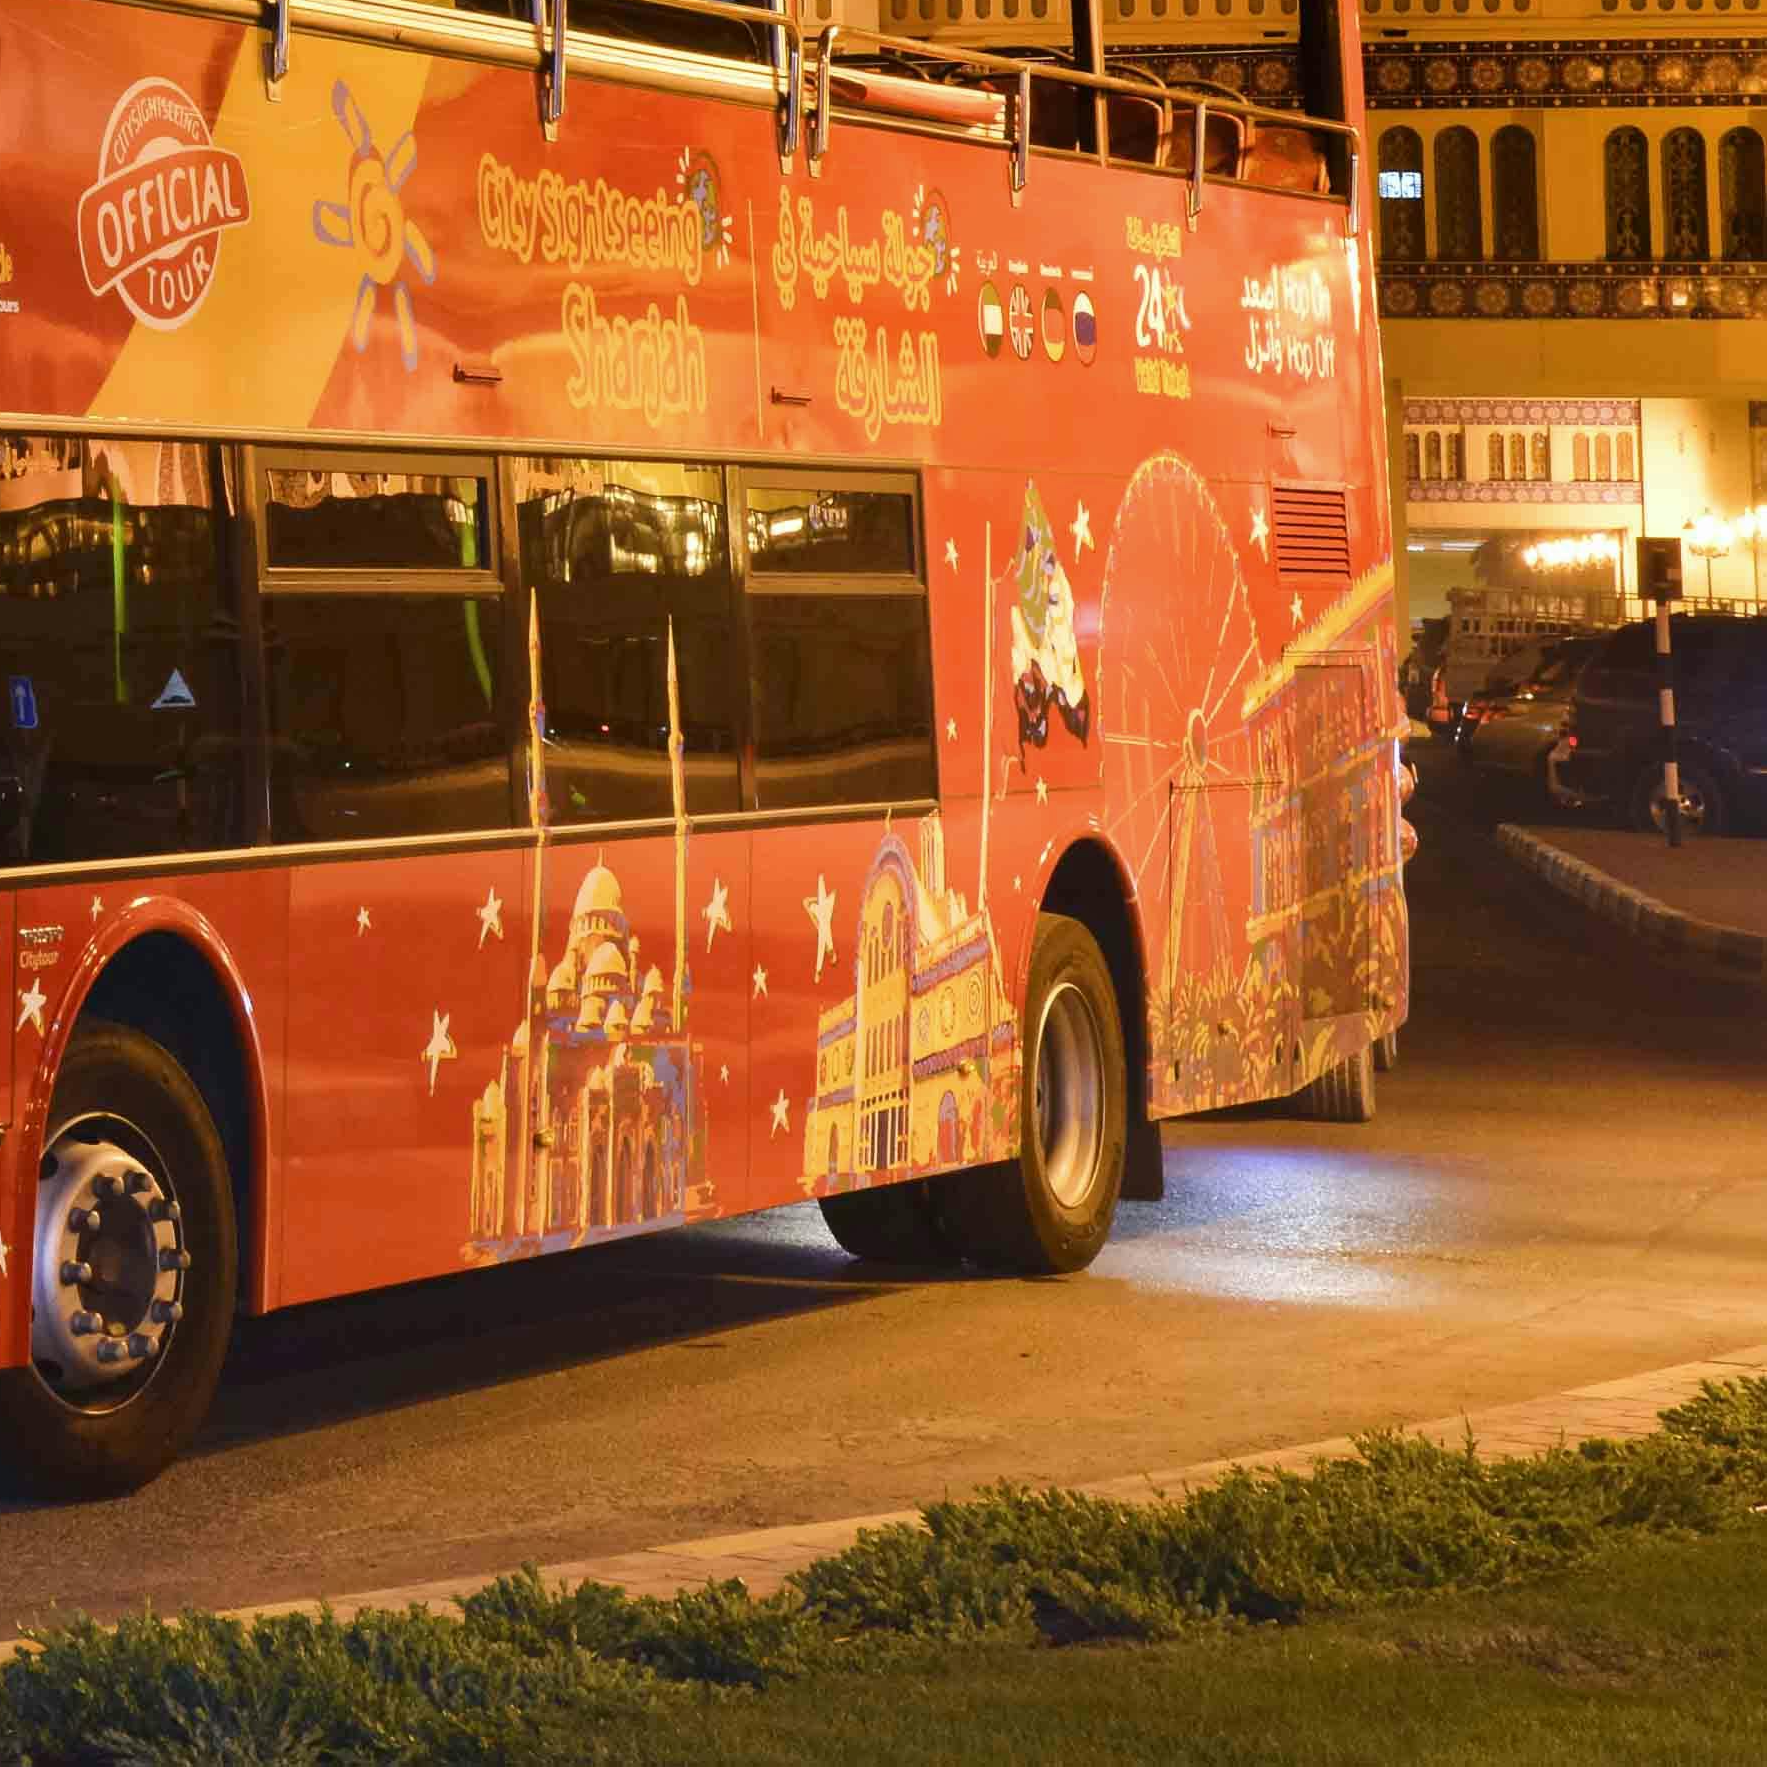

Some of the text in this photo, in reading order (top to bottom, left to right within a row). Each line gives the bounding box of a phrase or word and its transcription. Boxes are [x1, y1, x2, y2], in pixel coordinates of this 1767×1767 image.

[114, 96, 200, 165] CITYSIGHTSEEING
[97, 161, 242, 269] OFFICIAL
[146, 245, 211, 311] TOUR
[1133, 263, 1166, 350] 24
[561, 282, 706, 428] Sharjah
[834, 315, 941, 441] الشارقة
[1286, 332, 1335, 382] Hop Off
